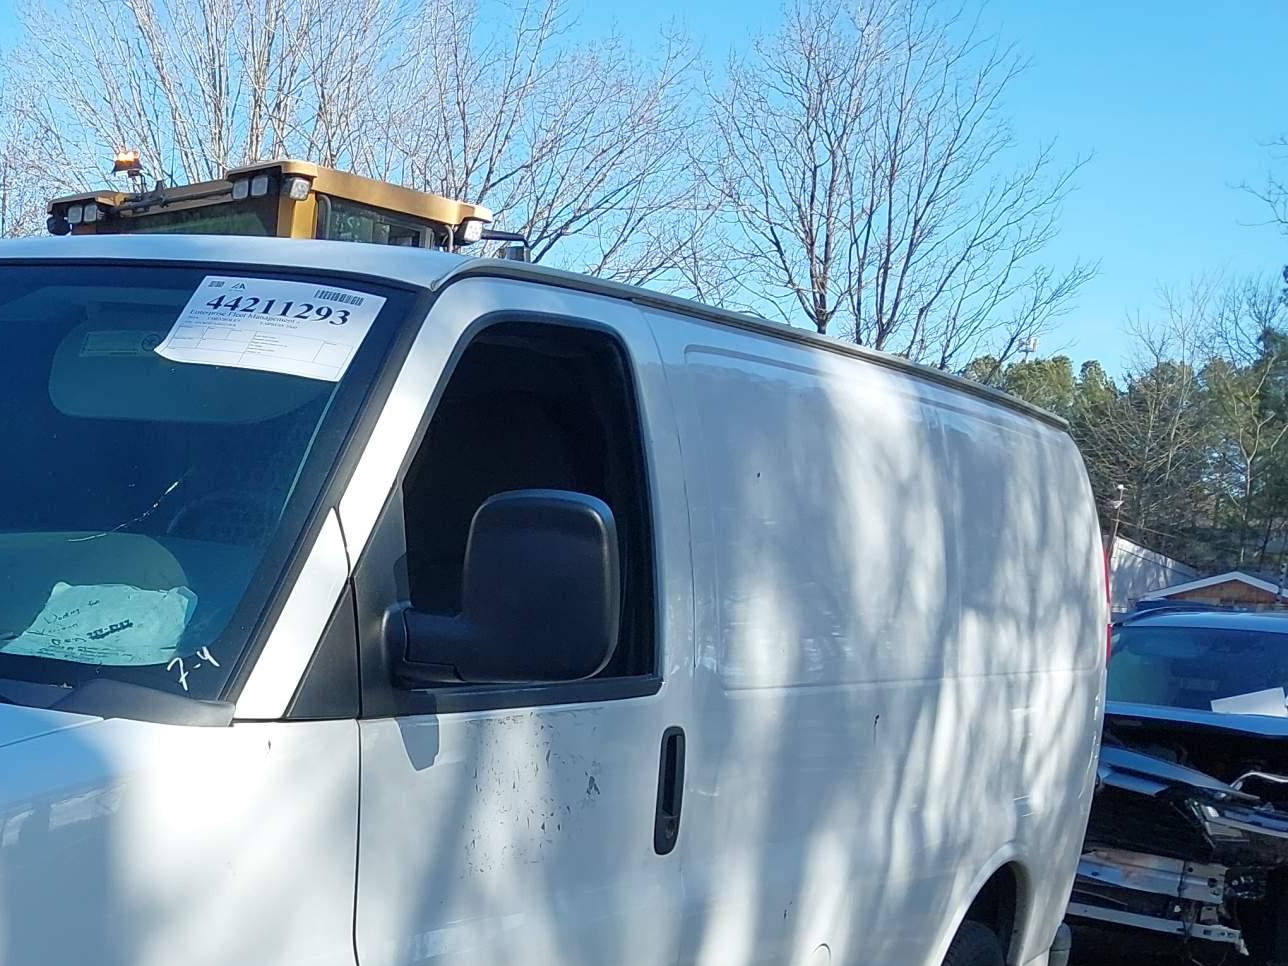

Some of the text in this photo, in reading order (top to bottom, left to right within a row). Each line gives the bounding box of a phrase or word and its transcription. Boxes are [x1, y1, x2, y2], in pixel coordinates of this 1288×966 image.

[190, 308, 226, 317] Enterprise
[228, 311, 246, 319] Fleet
[247, 313, 295, 324] Management
[206, 294, 352, 326] 44211293
